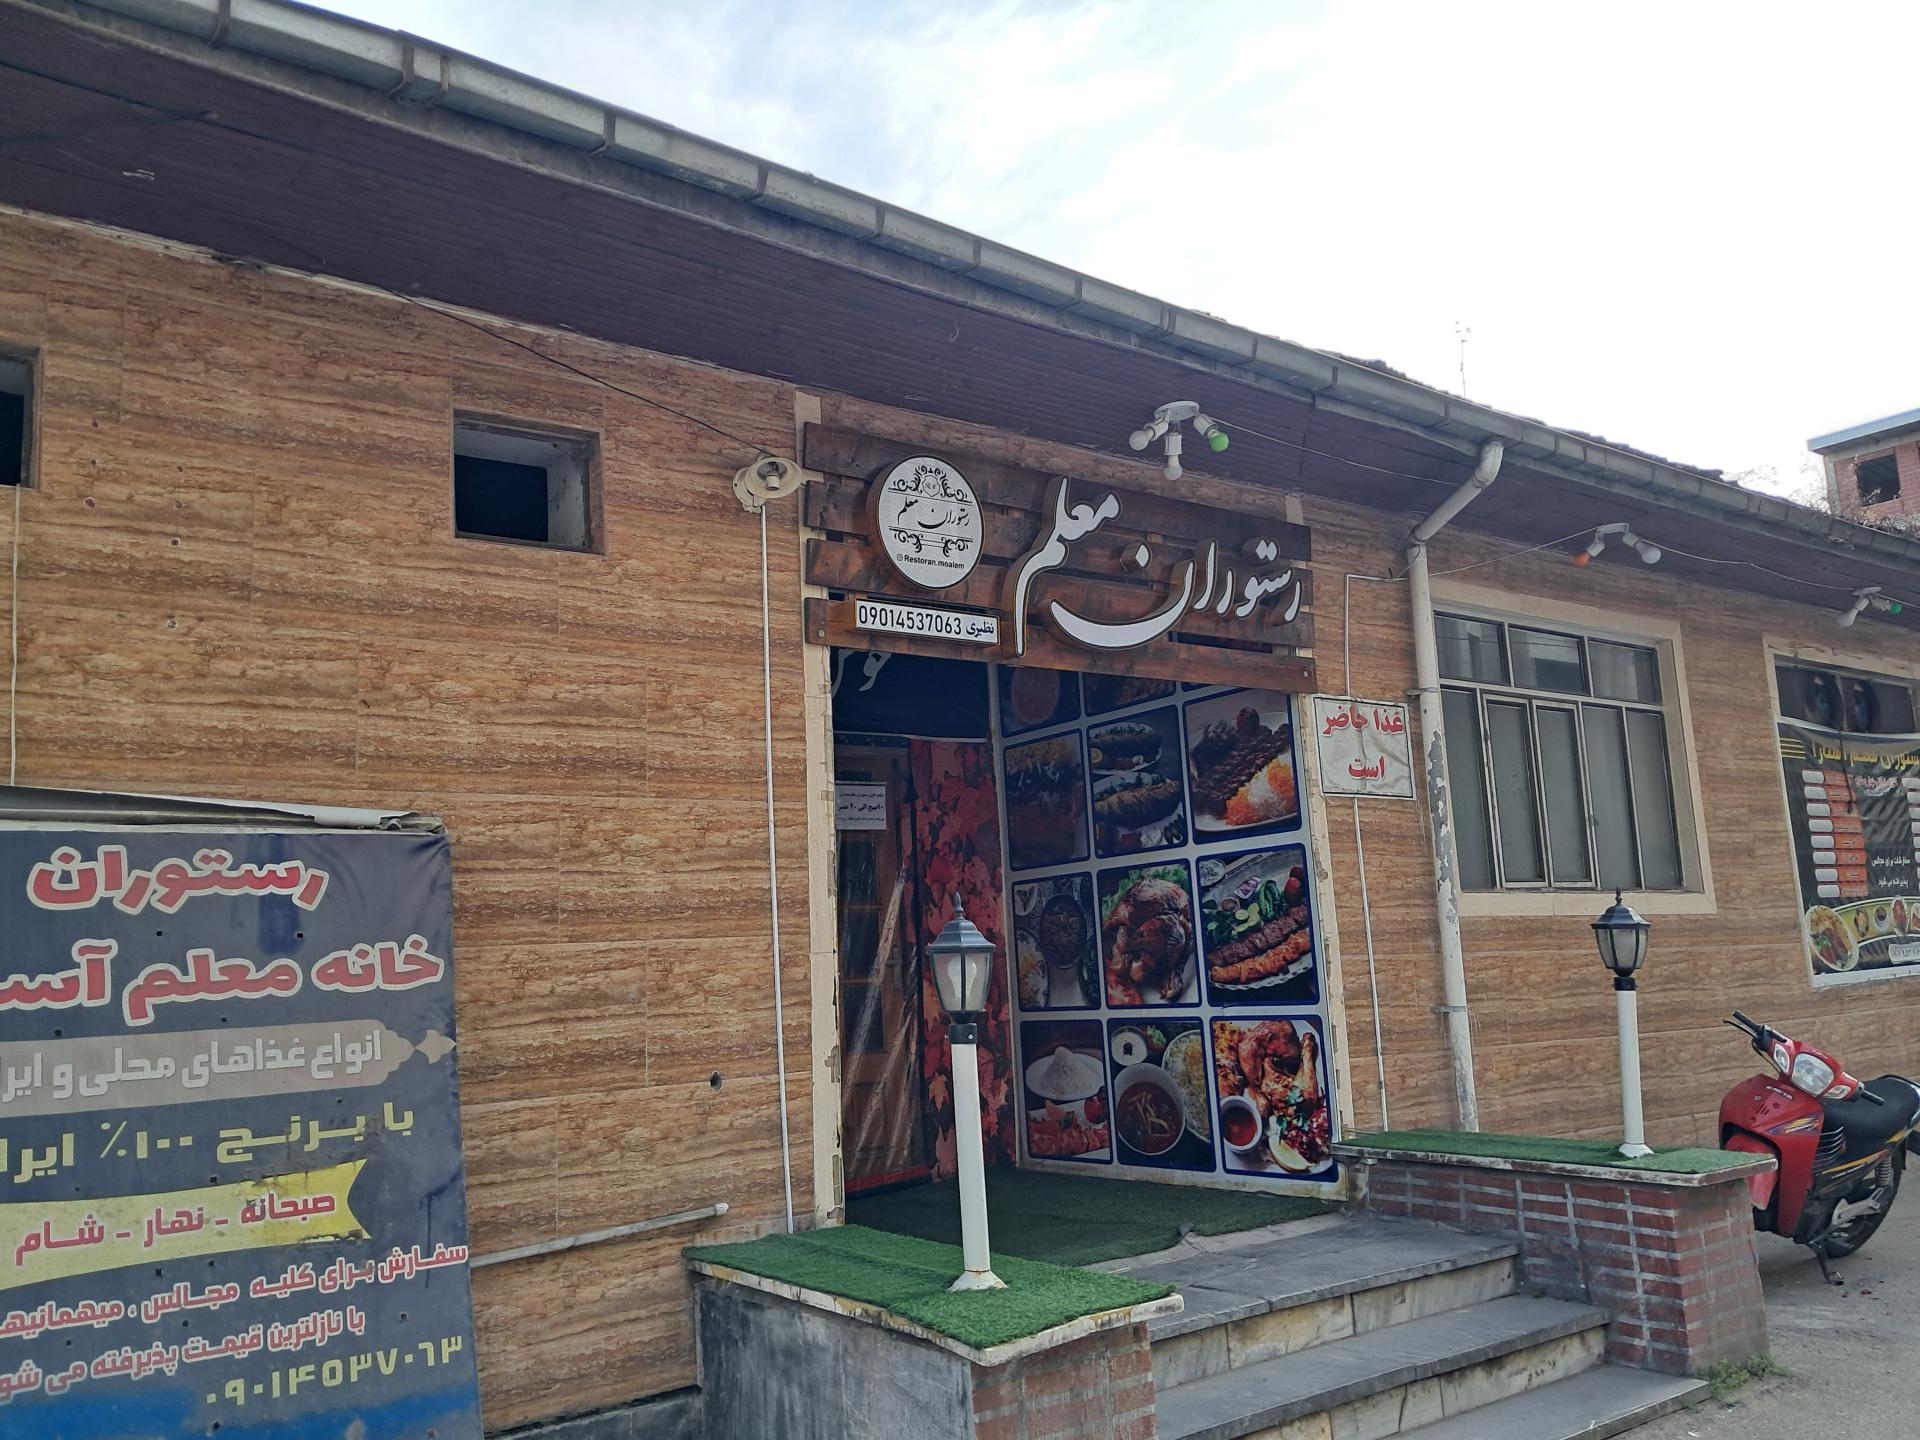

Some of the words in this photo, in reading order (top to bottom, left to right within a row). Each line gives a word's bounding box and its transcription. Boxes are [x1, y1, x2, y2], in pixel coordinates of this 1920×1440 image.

[897, 496, 919, 526] معلم
[917, 507, 970, 530] رستوران
[904, 554, 965, 570] Restoran.moalem
[1015, 476, 1120, 657] معلم
[1051, 537, 1301, 648] رستوران
[857, 603, 963, 636] 09014537063
[965, 621, 995, 638] نظیری
[1322, 703, 1369, 737] حاضر
[1372, 706, 1405, 735] غذا
[1347, 754, 1386, 781] است
[27, 845, 329, 914] رستوران
[0, 938, 118, 1011] آس
[311, 934, 445, 992] خانه
[122, 948, 303, 1027] معلم
[79, 1047, 176, 1097] محلی
[181, 1037, 305, 1088] غذاهای
[310, 1029, 382, 1079] انواع
[53, 1063, 73, 1099] و
[383, 1101, 415, 1136] با
[216, 1113, 367, 1163] برنج
[143, 1205, 205, 1248] نهار
[240, 1190, 337, 1225] صبحانه
[15, 1214, 105, 1266] شام
[250, 1262, 315, 1298] کلیه
[318, 1257, 375, 1293] برای
[378, 1243, 468, 1284] سفارش
[267, 1309, 343, 1350] نازلترین
[347, 1305, 365, 1335] با
[91, 1342, 179, 1380] پذیرفته
[183, 1324, 263, 1362] قیمت
[45, 1361, 87, 1396] می
